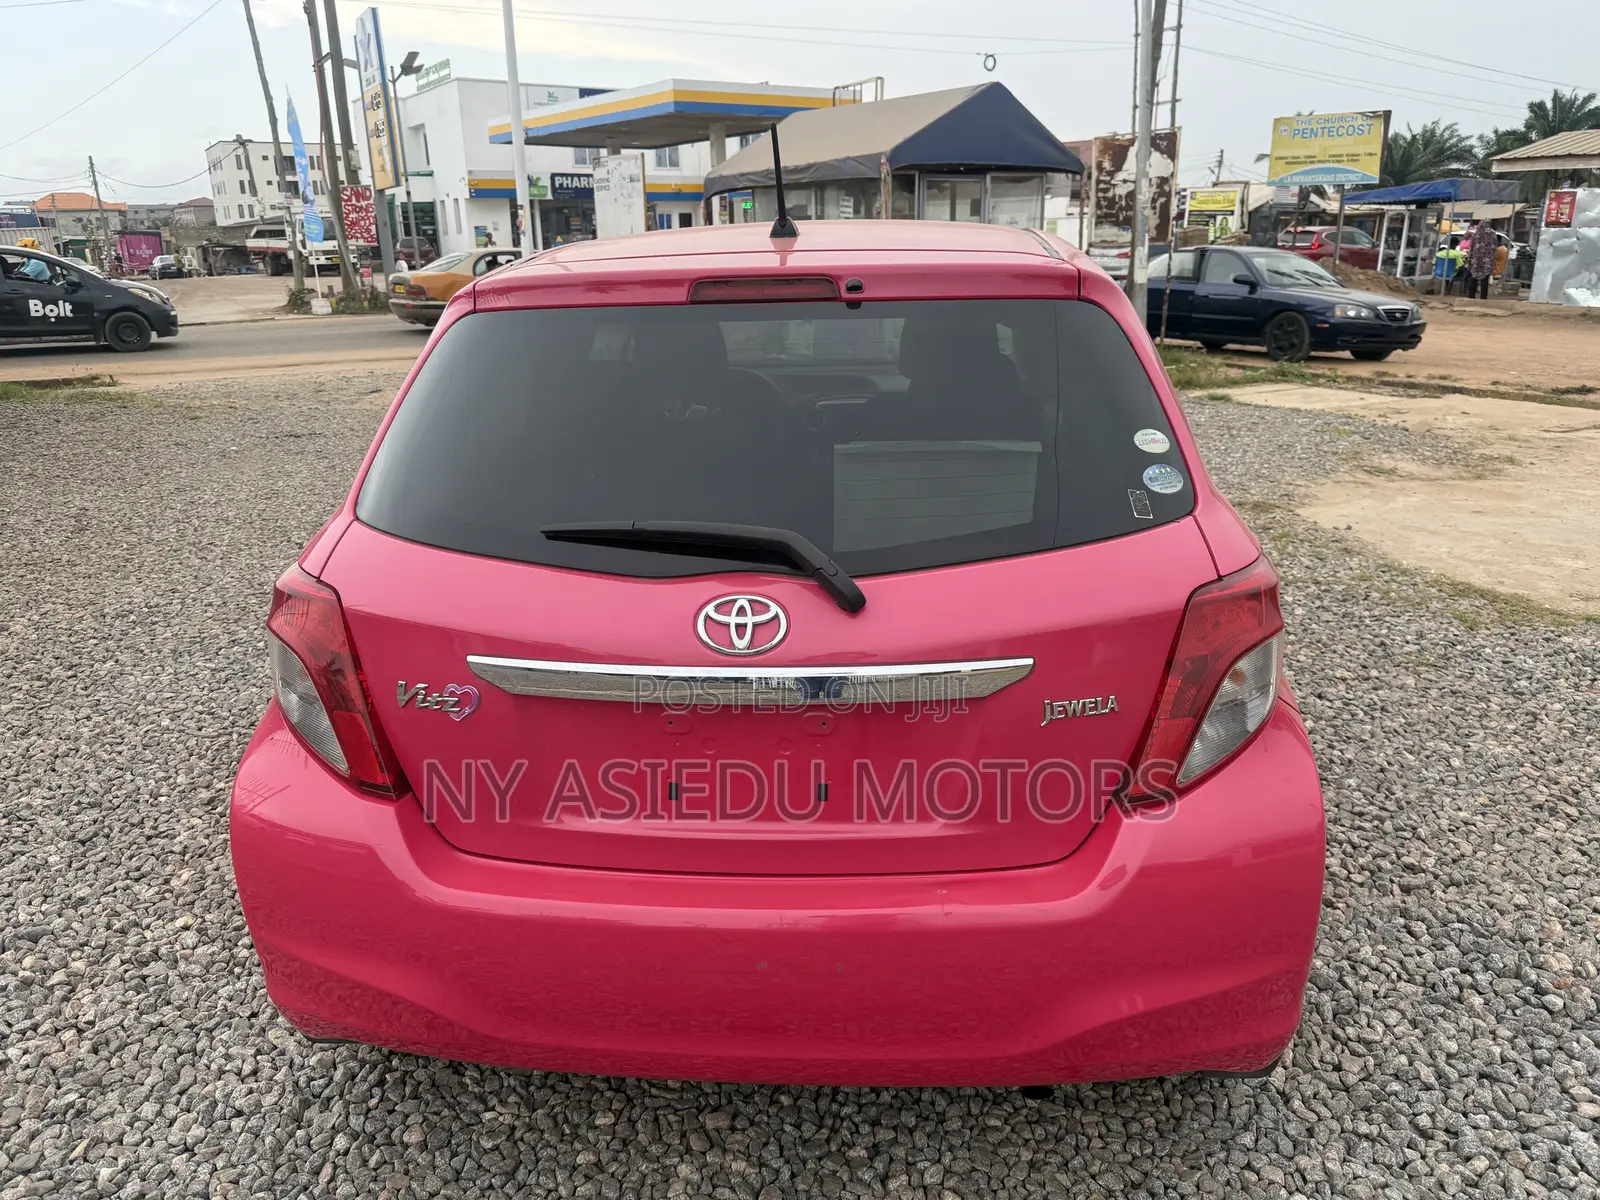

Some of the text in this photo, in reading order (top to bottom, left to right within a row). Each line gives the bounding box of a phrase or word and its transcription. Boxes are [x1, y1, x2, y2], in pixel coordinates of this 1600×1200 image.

[1296, 119, 1313, 127] THE
[1316, 115, 1358, 125] CHURCH
[1292, 123, 1375, 140] PENTECOST
[341, 186, 373, 203] SAND
[28, 299, 74, 322] Bolt
[397, 680, 461, 712] Vitz
[1040, 695, 1119, 727] JEWELA
